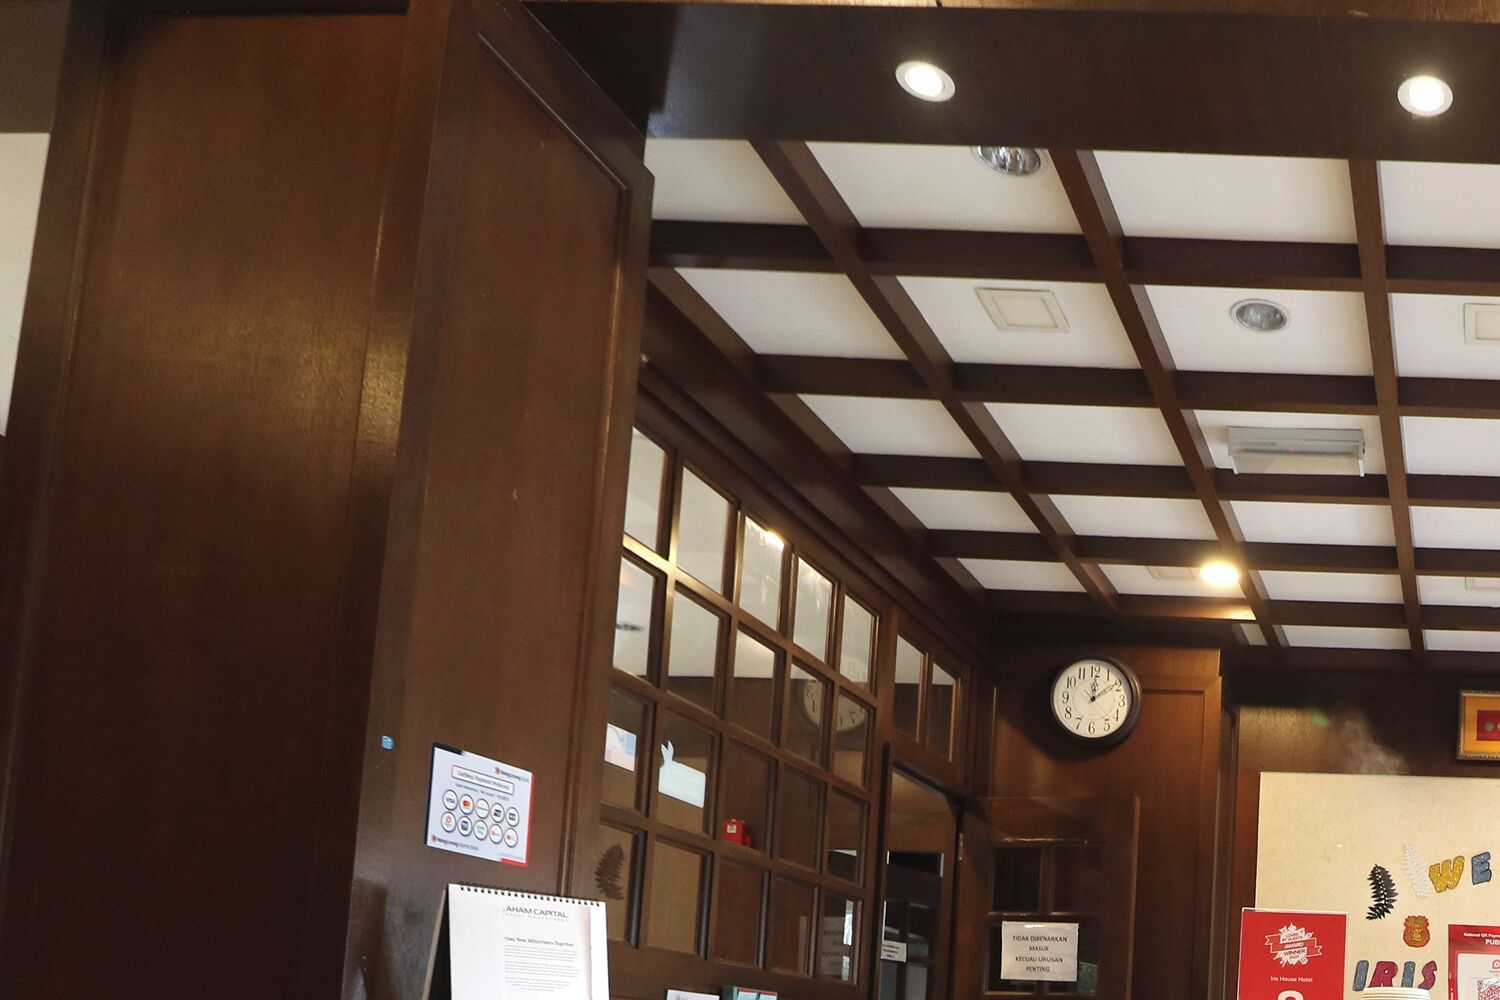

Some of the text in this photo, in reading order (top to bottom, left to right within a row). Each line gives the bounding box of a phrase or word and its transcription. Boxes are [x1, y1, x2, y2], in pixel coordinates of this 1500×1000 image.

[1078, 667, 1086, 680] 11
[1090, 665, 1100, 678] 12
[1066, 676, 1077, 689] 10
[1114, 679, 1122, 692] 2
[1062, 691, 1069, 704] 9
[1118, 695, 1126, 707] 3
[1064, 707, 1072, 719] 8
[1075, 717, 1083, 730] 7
[1088, 721, 1095, 734] 6
[1103, 718, 1111, 731] 5
[506, 905, 569, 919] AHAM CAPITAL
[1352, 959, 1438, 992] IRIS
